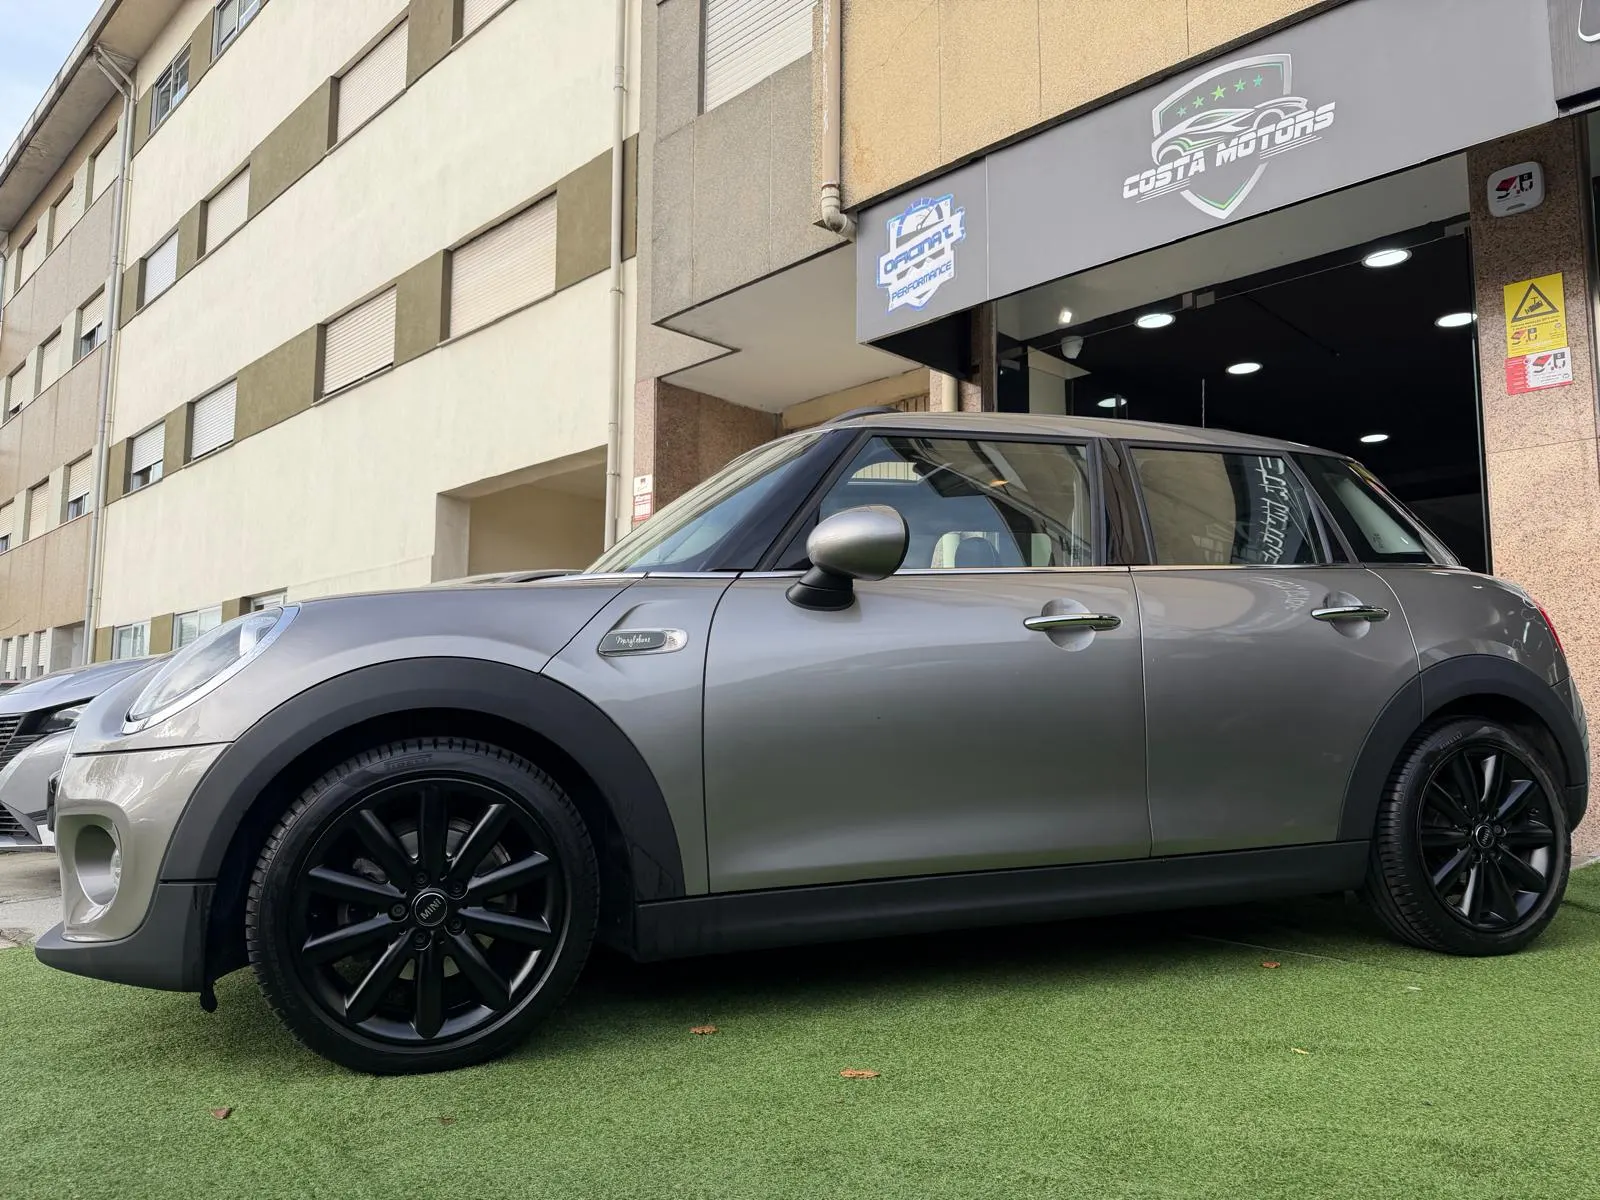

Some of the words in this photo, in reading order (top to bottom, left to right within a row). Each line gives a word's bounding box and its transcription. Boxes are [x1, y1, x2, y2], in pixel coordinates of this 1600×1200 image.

[1123, 151, 1206, 199] COSTA
[1215, 101, 1336, 167] MOTORS
[891, 260, 952, 302] PERFORMANCE
[420, 898, 442, 920] MINI
